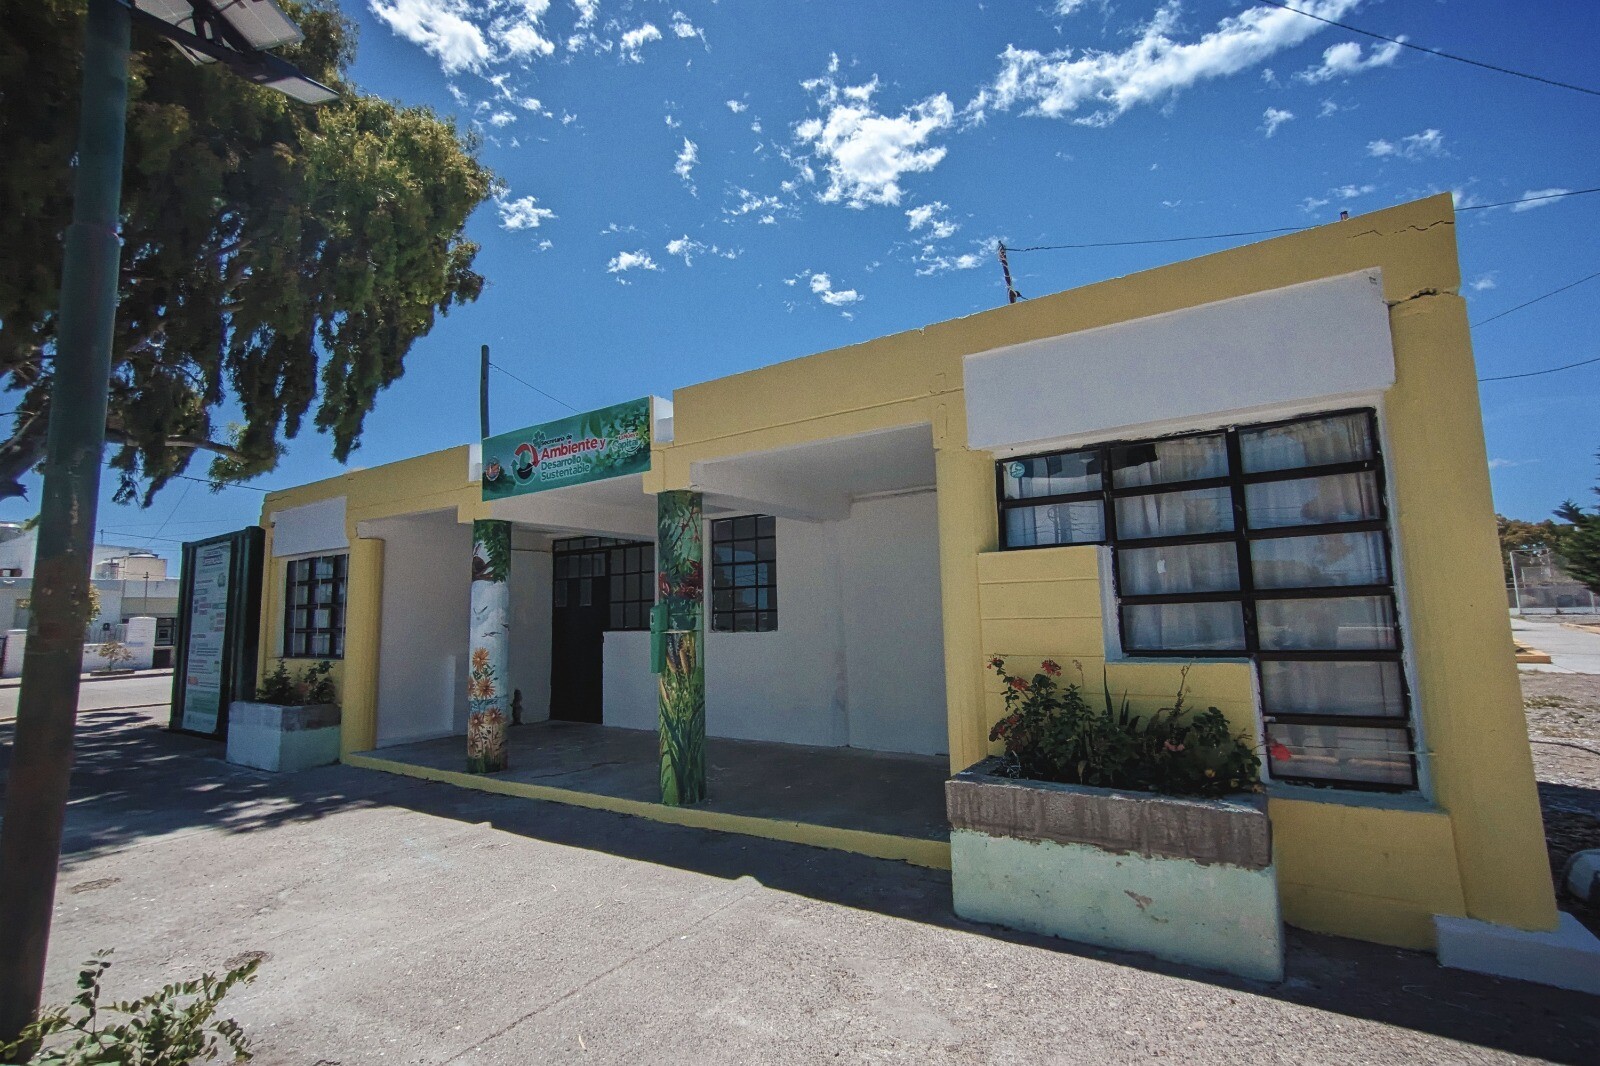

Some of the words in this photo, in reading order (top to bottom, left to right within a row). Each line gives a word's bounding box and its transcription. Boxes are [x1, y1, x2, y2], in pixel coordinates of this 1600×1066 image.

[541, 438, 598, 460] Ambiente
[600, 438, 606, 450] y
[541, 455, 581, 471] Desarrollo
[541, 464, 590, 481] Sustentable
